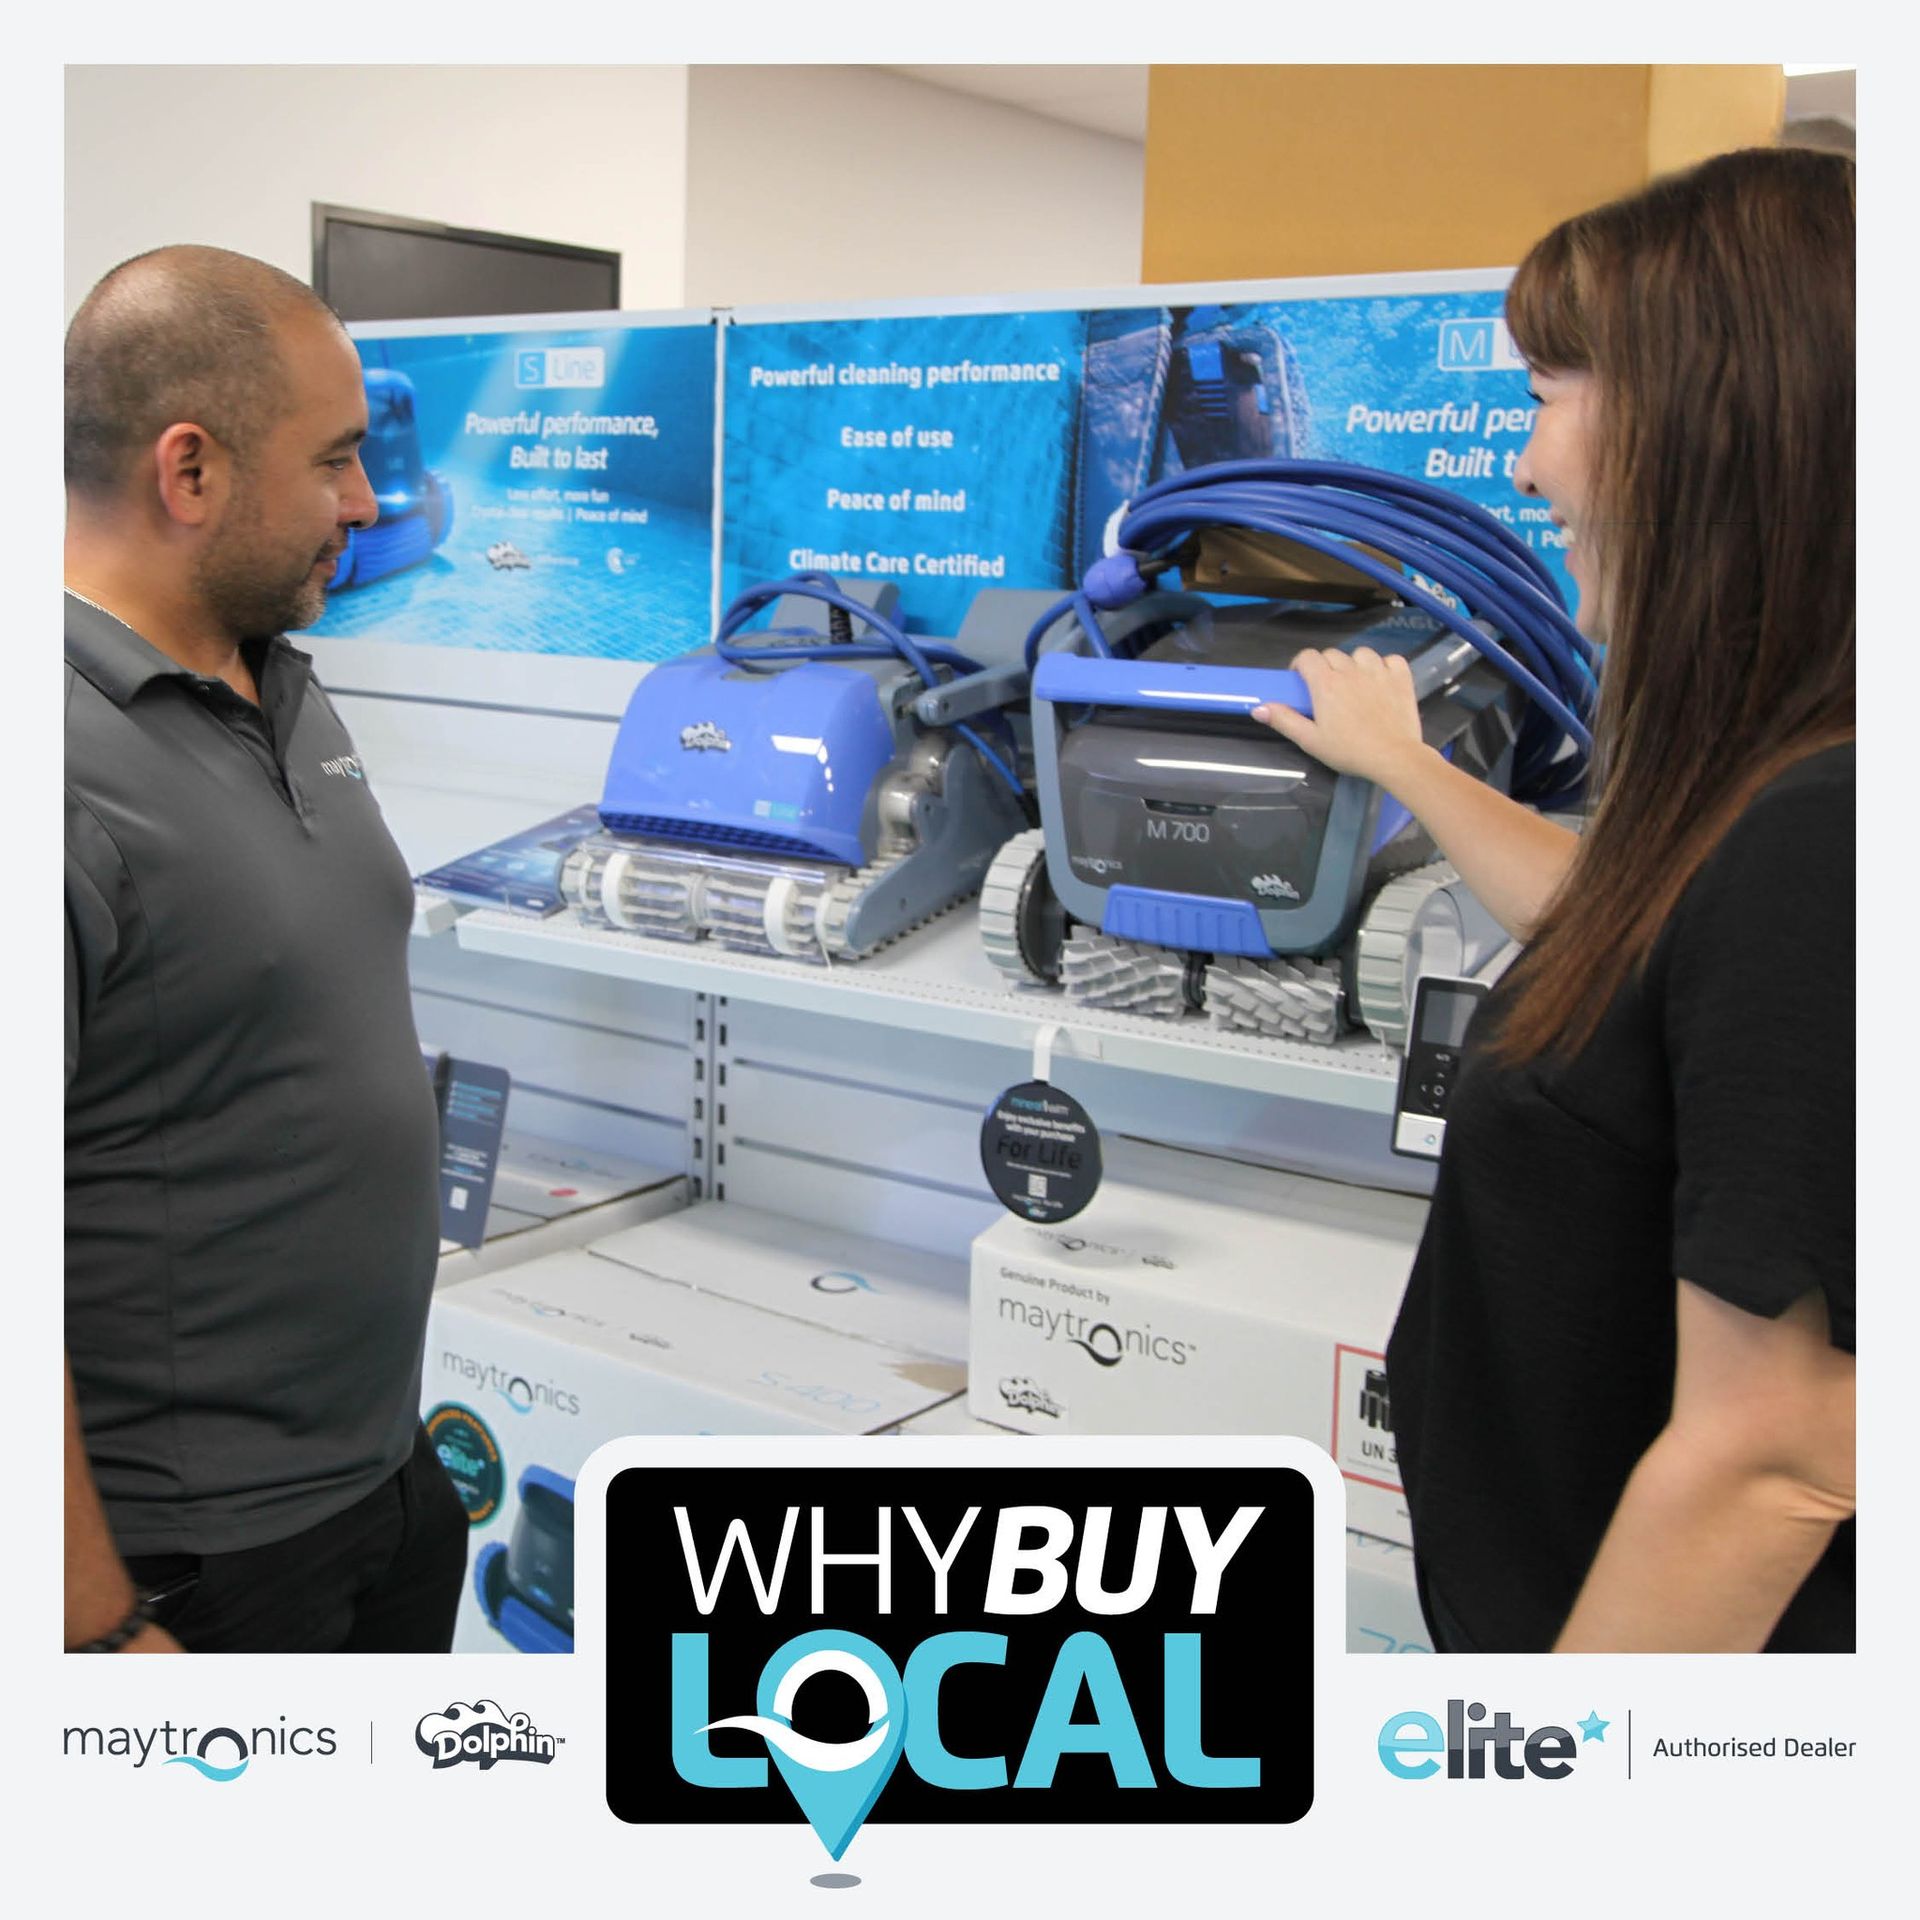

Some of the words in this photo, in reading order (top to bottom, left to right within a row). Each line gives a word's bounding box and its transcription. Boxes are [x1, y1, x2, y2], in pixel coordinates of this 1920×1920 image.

[1449, 329, 1486, 361] M
[522, 355, 540, 381] S
[552, 354, 596, 381] Line
[750, 364, 835, 388] Powerful
[839, 363, 922, 388] cleaning
[926, 360, 1060, 388] performance
[465, 411, 540, 436] Powerful
[541, 411, 659, 439] performance,
[1346, 402, 1480, 434] Powerful
[841, 427, 887, 447] Ease
[892, 427, 913, 447] of
[917, 430, 953, 447] use
[510, 446, 550, 469] Built
[553, 449, 573, 469] to
[575, 447, 608, 470] last
[1425, 448, 1495, 477] Built
[827, 489, 883, 511] Peace
[889, 490, 911, 511] of
[914, 489, 966, 512] mind
[789, 549, 861, 572] Climate
[865, 551, 909, 573] Care
[914, 553, 1004, 577] Certified
[1147, 820, 1167, 840] M
[1172, 821, 1210, 843] 700
[997, 1135, 1032, 1159] For
[1038, 1141, 1082, 1170] Life
[1000, 1267, 1044, 1288] Genuine
[1049, 1278, 1093, 1300] Product
[1096, 1291, 1110, 1305] by
[999, 1298, 1187, 1367] maytronics
[443, 1351, 581, 1415] maytronics
[1361, 1440, 1385, 1459] UN
